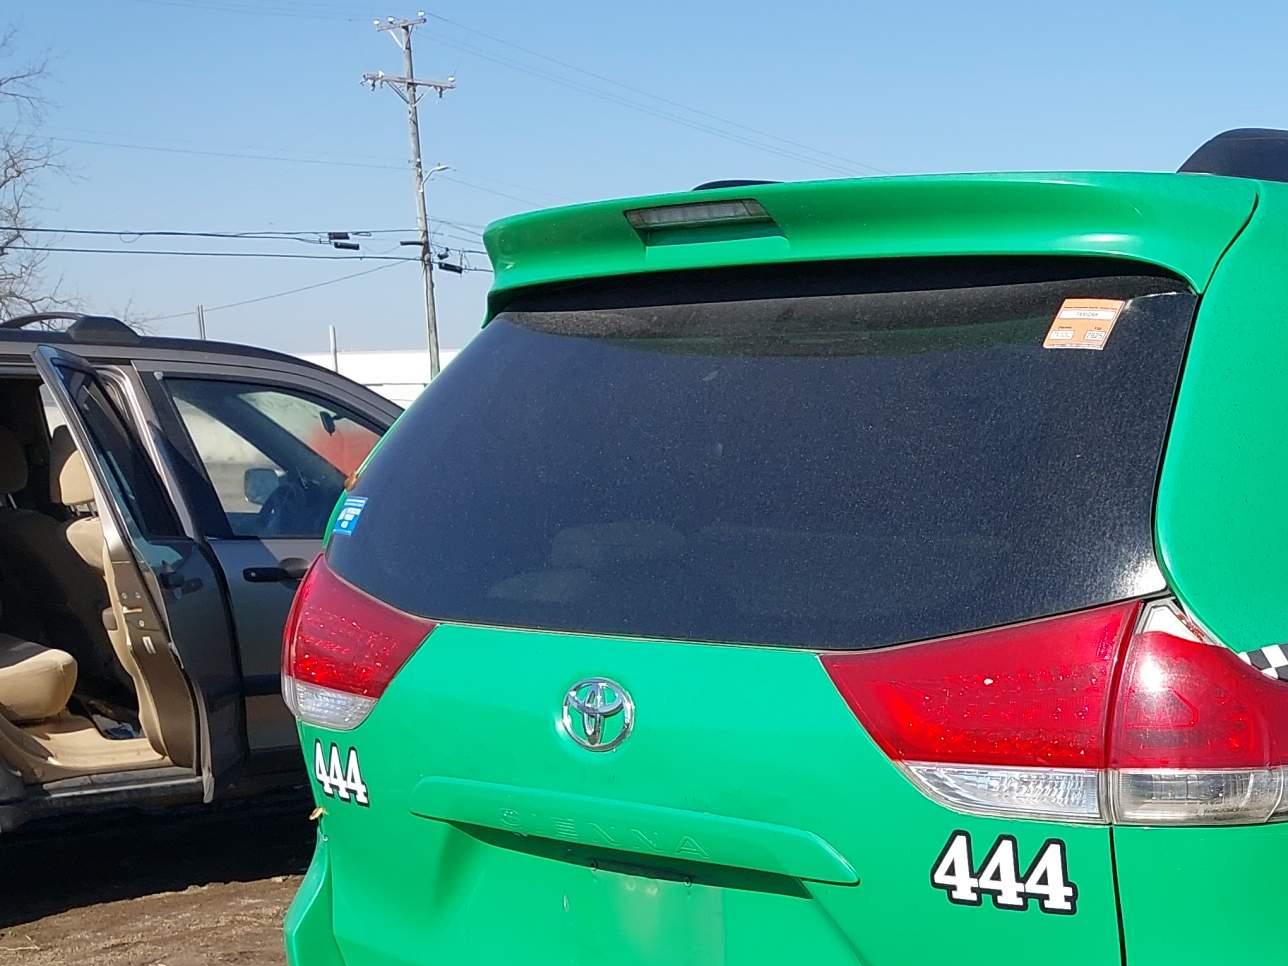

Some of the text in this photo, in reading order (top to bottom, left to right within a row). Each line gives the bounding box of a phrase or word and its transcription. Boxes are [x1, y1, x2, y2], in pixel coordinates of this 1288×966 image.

[314, 738, 369, 807] 444
[499, 807, 711, 860] SENNA
[931, 830, 1078, 915] 444
